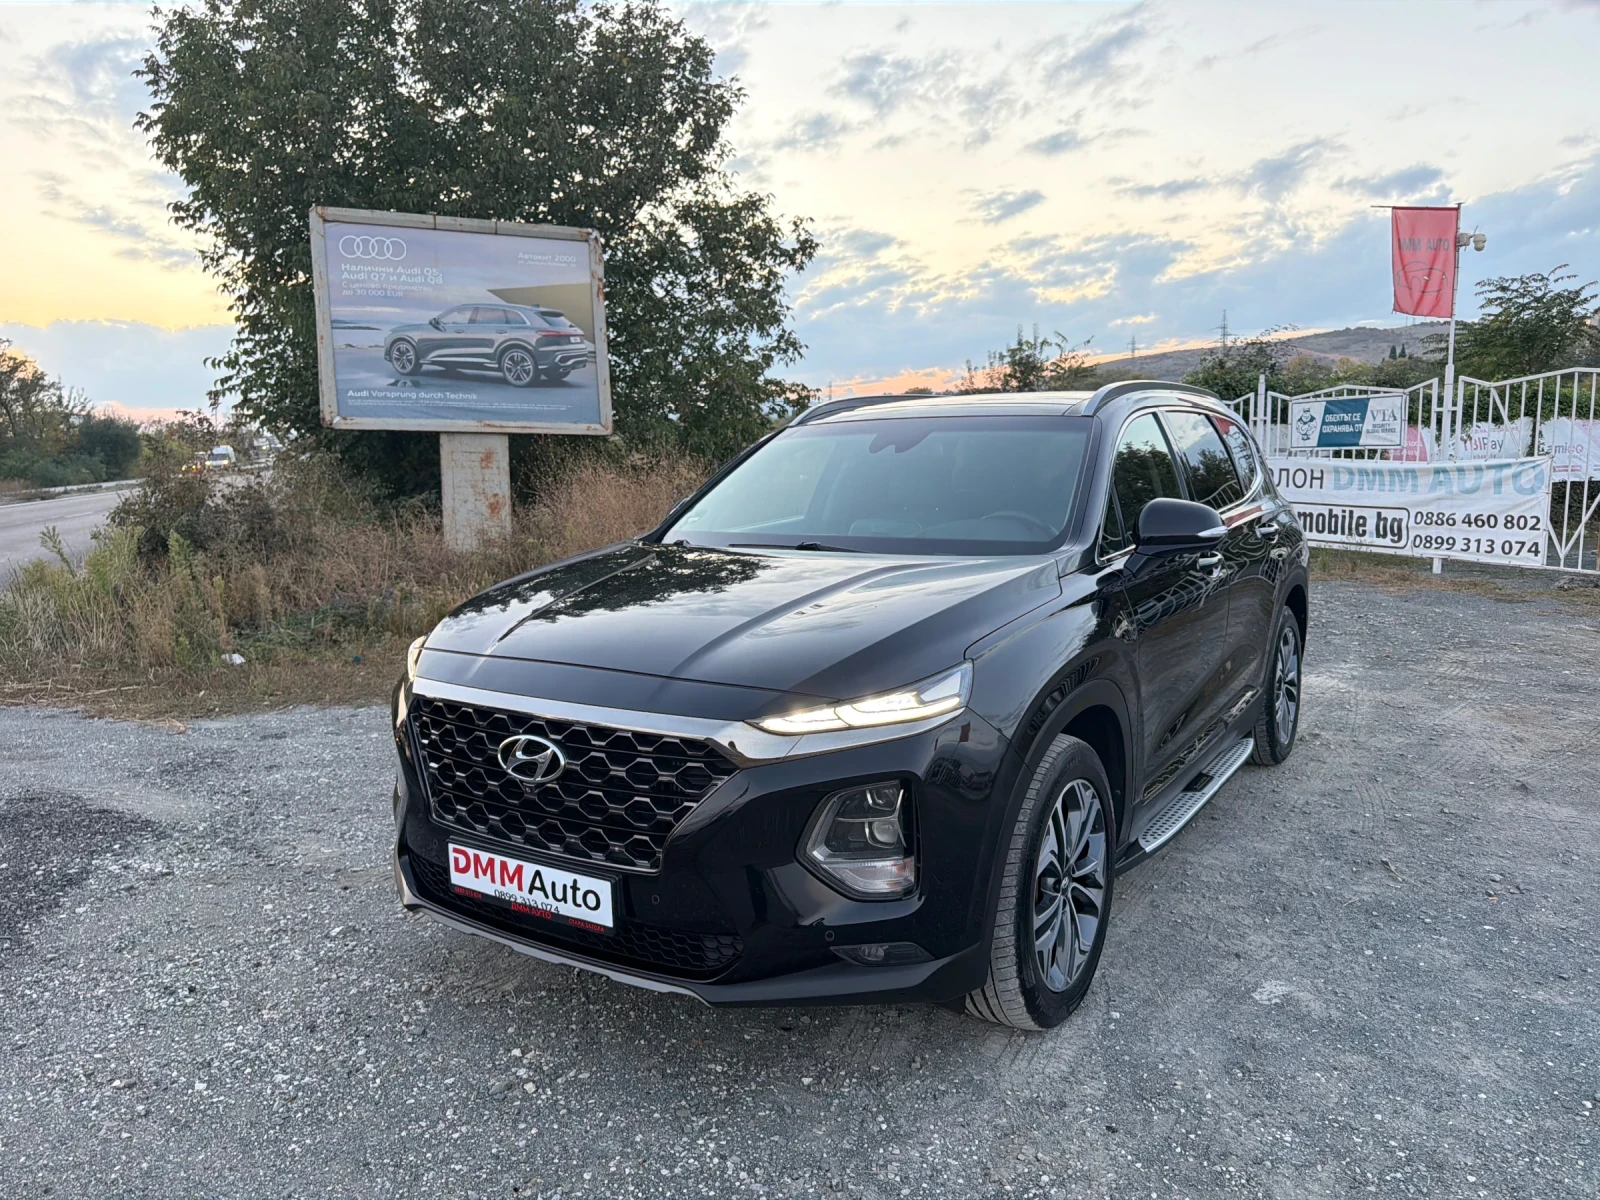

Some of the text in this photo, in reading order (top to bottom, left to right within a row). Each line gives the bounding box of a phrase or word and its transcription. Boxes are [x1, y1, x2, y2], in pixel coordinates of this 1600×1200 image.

[1426, 237, 1450, 251] AUTO
[555, 254, 576, 263] 2000
[341, 263, 393, 273] Налични
[397, 266, 421, 275] Audi
[341, 271, 368, 280] Audi
[370, 273, 386, 282] Q7
[400, 274, 425, 283] Audi
[427, 276, 443, 285] Q8
[368, 289, 385, 297] 000
[370, 390, 417, 399] Vorsprung
[418, 391, 444, 399] durch
[445, 391, 478, 400] Technik
[1325, 412, 1361, 422] ОБЕКТЪТ СЕ
[1370, 408, 1397, 422] VTA
[1322, 423, 1363, 433] ОХРАНЯВА ОТ
[1333, 466, 1418, 493] DMM
[1428, 462, 1545, 496] AUTO
[1297, 508, 1403, 544] mobile.bg
[1414, 511, 1541, 531] 0886 460 802
[1413, 534, 1540, 557] 0899 313 074
[494, 889, 518, 902] 0899
[520, 896, 539, 909] 313
[541, 902, 560, 914] 074
